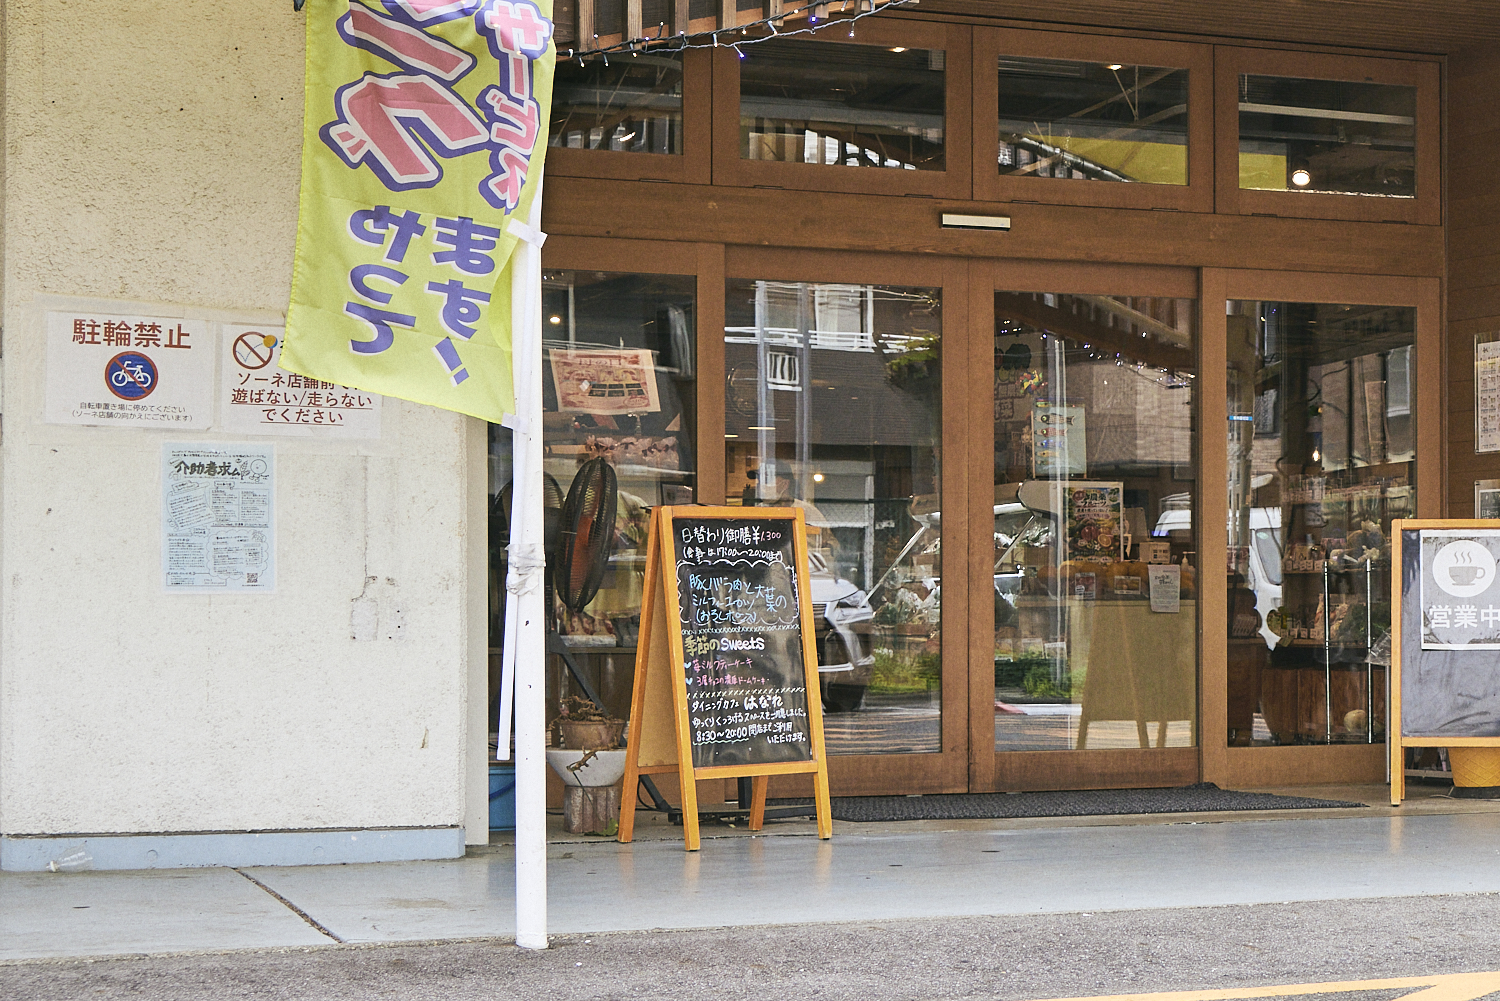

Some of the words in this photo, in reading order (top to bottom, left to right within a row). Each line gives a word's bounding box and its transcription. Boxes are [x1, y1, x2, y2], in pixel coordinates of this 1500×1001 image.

[72, 318, 192, 349] 駐輪禁止
[231, 388, 372, 407] 遊ばない/走らない
[80, 402, 186, 413] 自転車置き場に停めてください
[262, 408, 343, 424] でください
